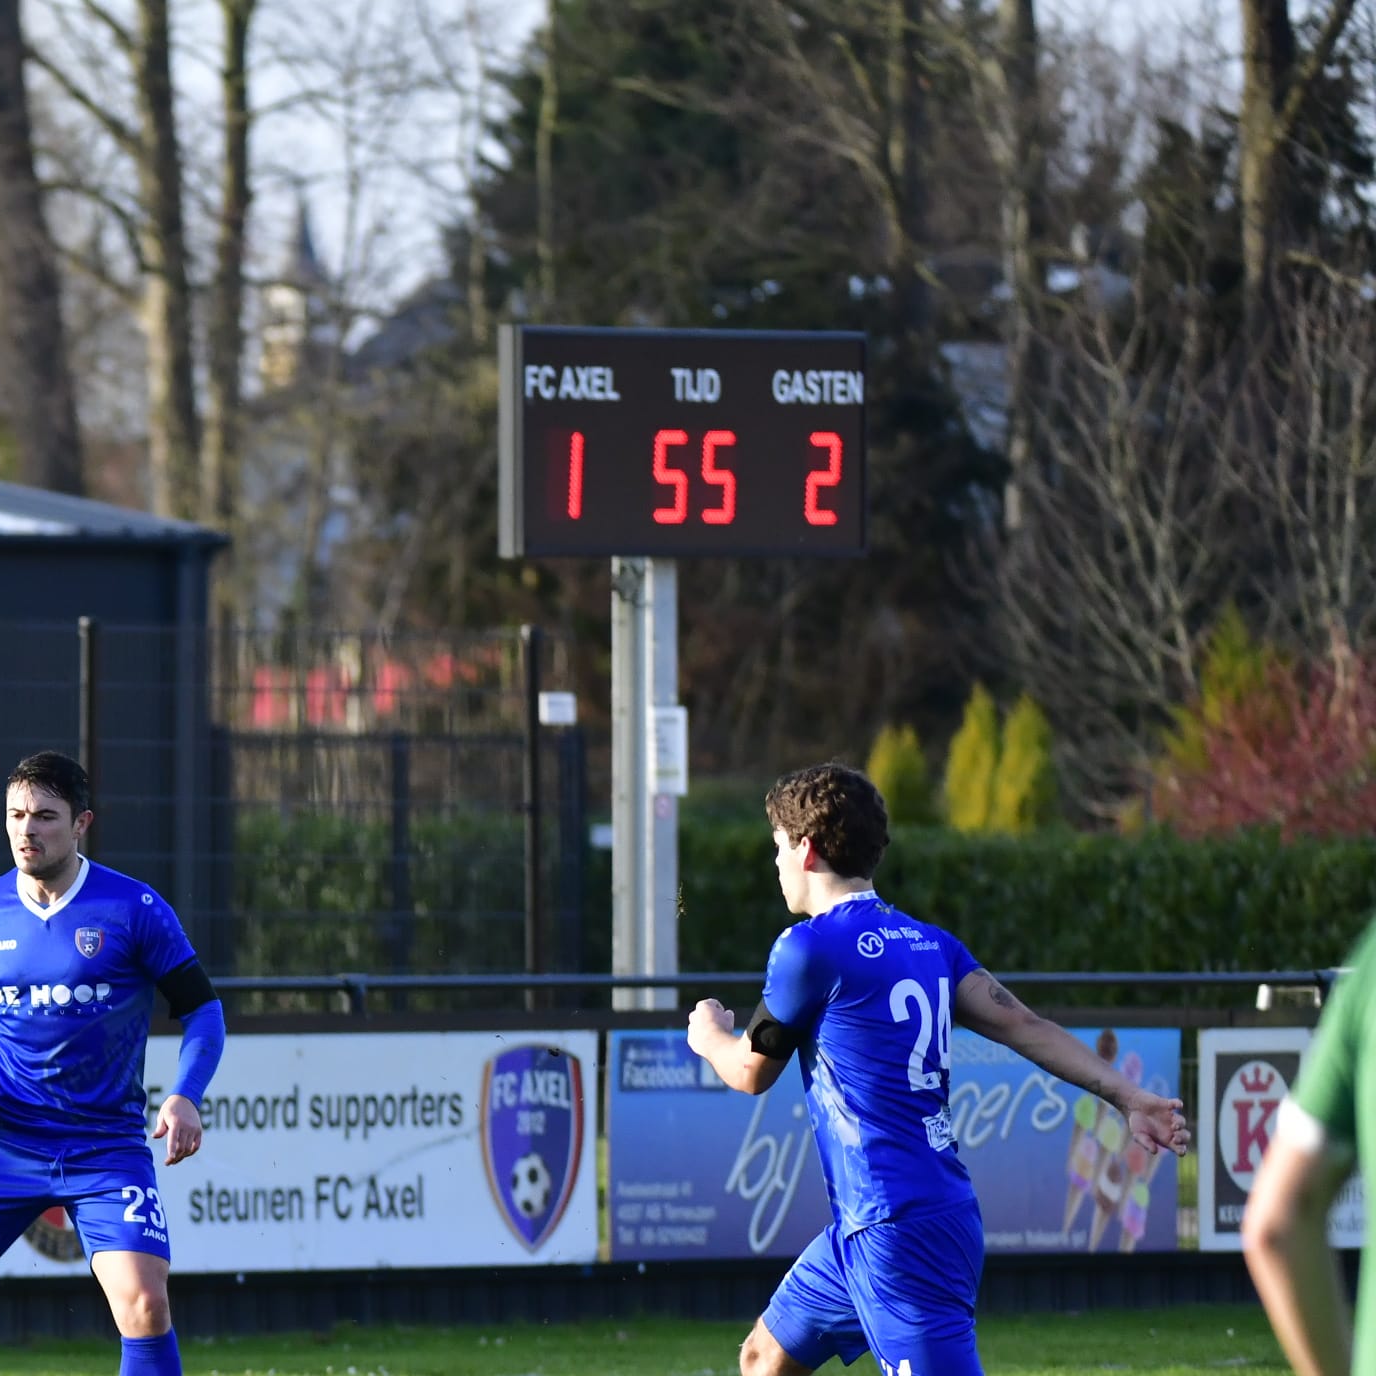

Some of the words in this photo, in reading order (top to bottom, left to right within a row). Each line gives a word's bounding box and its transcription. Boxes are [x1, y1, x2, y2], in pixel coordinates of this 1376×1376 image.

[525, 365, 555, 398] FC
[559, 366, 621, 401] AXEL
[670, 368, 721, 402] TIJD
[773, 369, 863, 404] GASTEN
[567, 432, 584, 519] 1
[653, 429, 737, 525] 55
[804, 431, 843, 526] 2
[29, 983, 113, 1008] HOOP
[145, 1085, 299, 1130] Fenoord
[310, 1086, 464, 1139] supporters
[492, 1071, 518, 1111] FC
[520, 1069, 570, 1109] AXEL
[1233, 1101, 1280, 1172] K
[121, 1185, 167, 1230] 23
[188, 1180, 303, 1224] steunen
[315, 1177, 352, 1220] FC
[362, 1174, 425, 1219] Axel
[142, 1227, 167, 1244] JAKO
